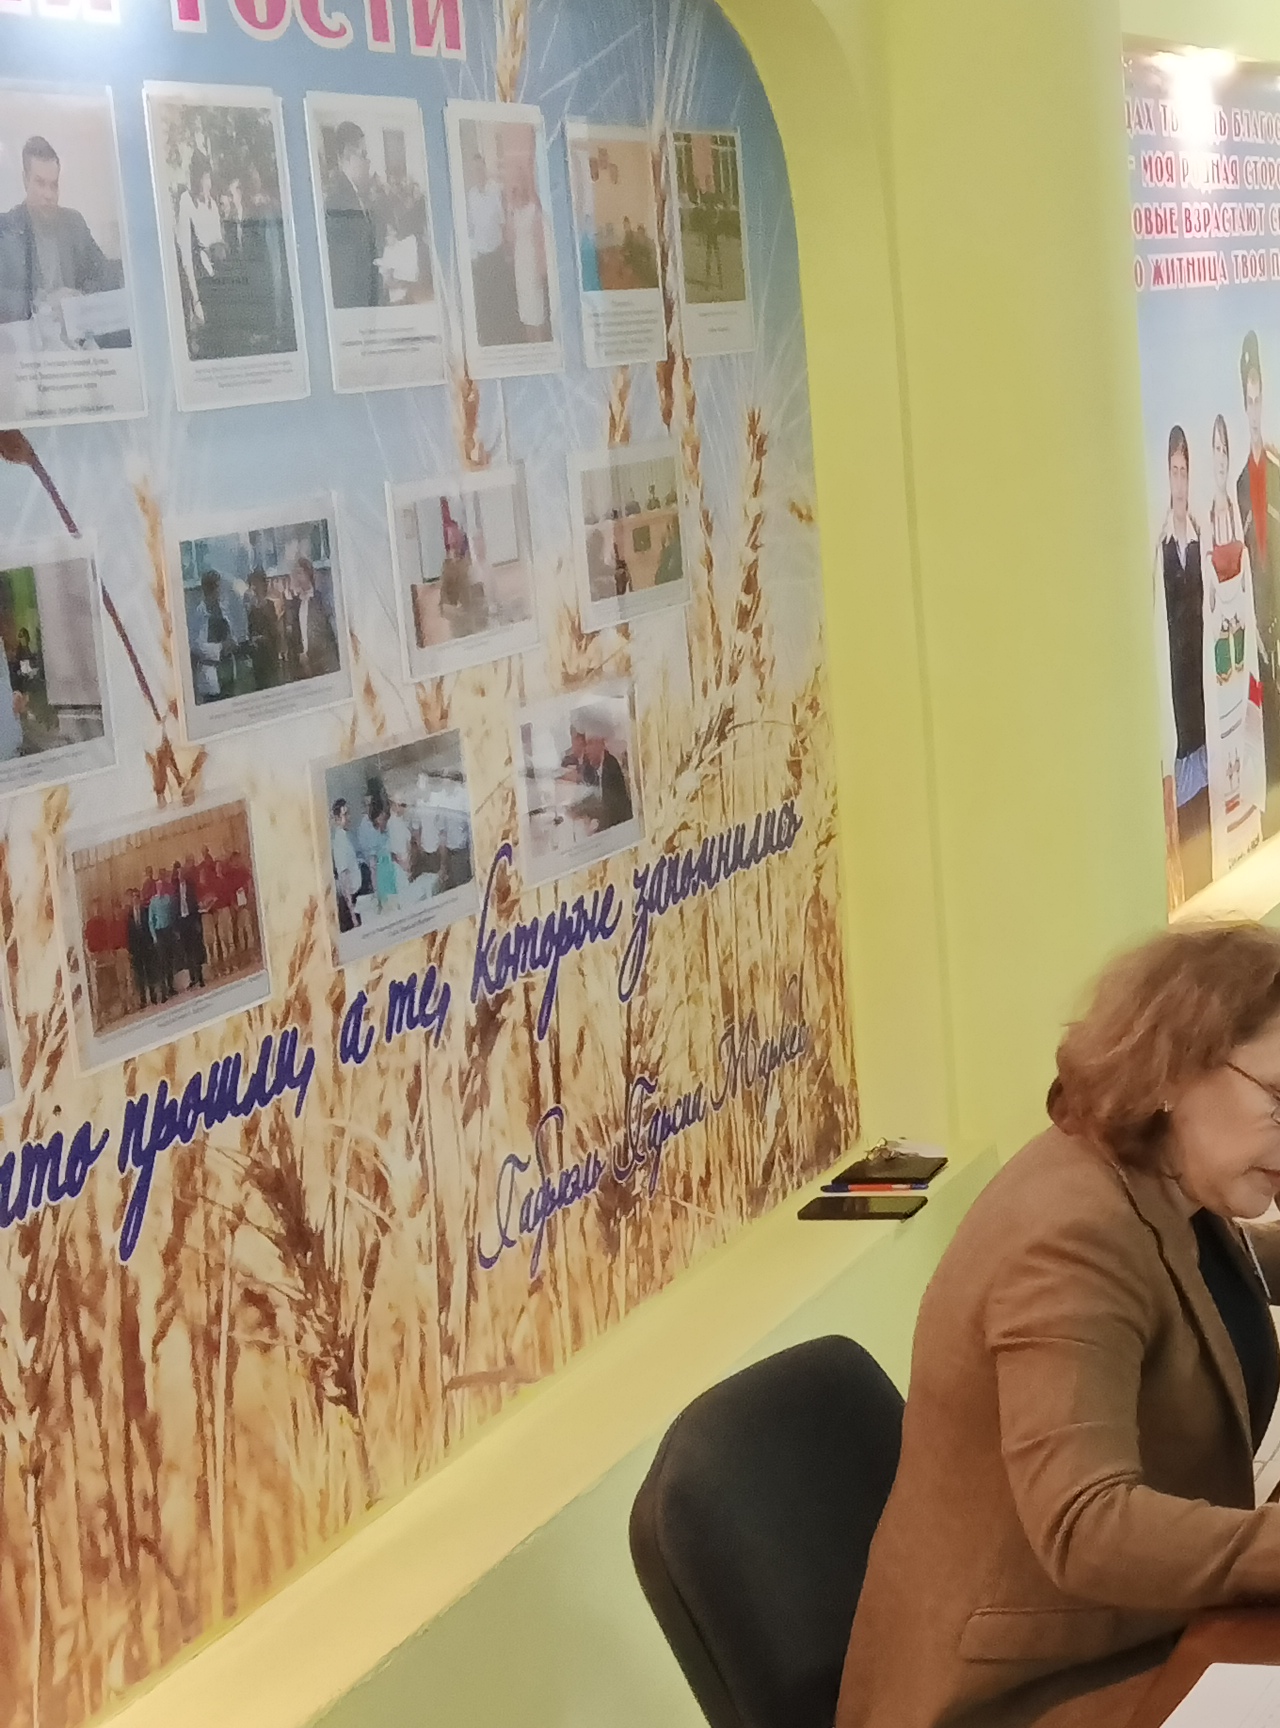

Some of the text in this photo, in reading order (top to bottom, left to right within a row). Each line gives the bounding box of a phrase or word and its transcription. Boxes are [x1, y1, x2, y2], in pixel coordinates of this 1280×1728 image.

[1142, 154, 1175, 184] МОЯ
[1181, 157, 1240, 187] РНАЯ
[1183, 205, 1266, 235] ВЗРАСТАЮТ
[1150, 255, 1228, 288] ЖИТНИЦА
[1232, 252, 1267, 280] ТВОЯ
[339, 989, 376, 1065] а
